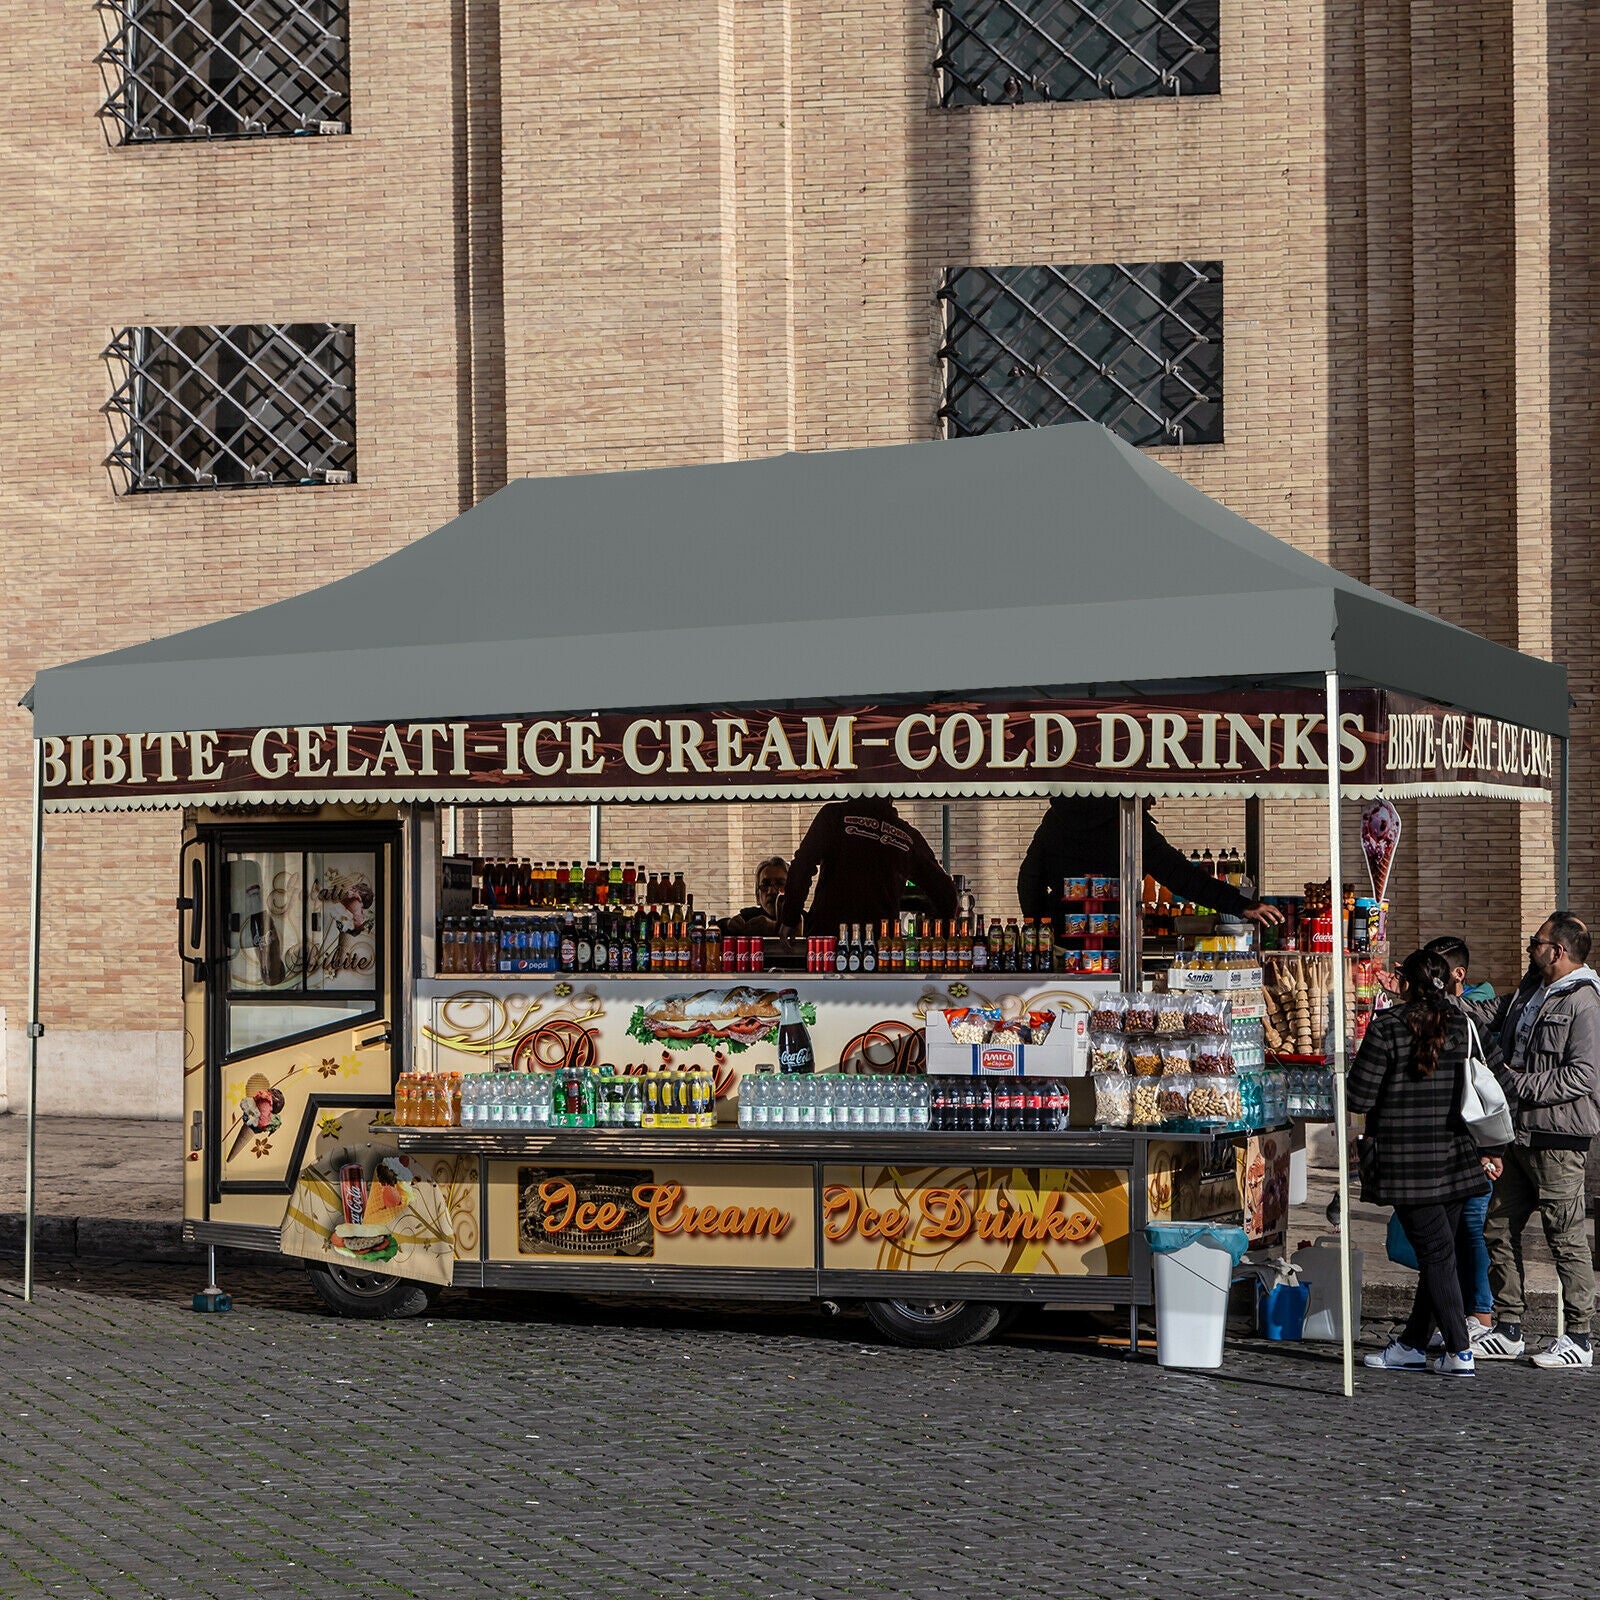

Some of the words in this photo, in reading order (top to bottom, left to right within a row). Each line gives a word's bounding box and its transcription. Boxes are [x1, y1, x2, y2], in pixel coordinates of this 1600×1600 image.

[43, 720, 606, 787] BIBITE-GELATI-ICE
[622, 712, 1077, 775] CREAM-COLD
[1095, 713, 1368, 772] DRINKS
[529, 961, 548, 969] pepsi
[983, 1053, 1013, 1061] AMICA
[345, 1185, 363, 1225] ca-Cola
[538, 1177, 628, 1233] Ice
[632, 1179, 791, 1236] Cream
[823, 1184, 909, 1240] Ice
[918, 1184, 1099, 1242] Drinks
